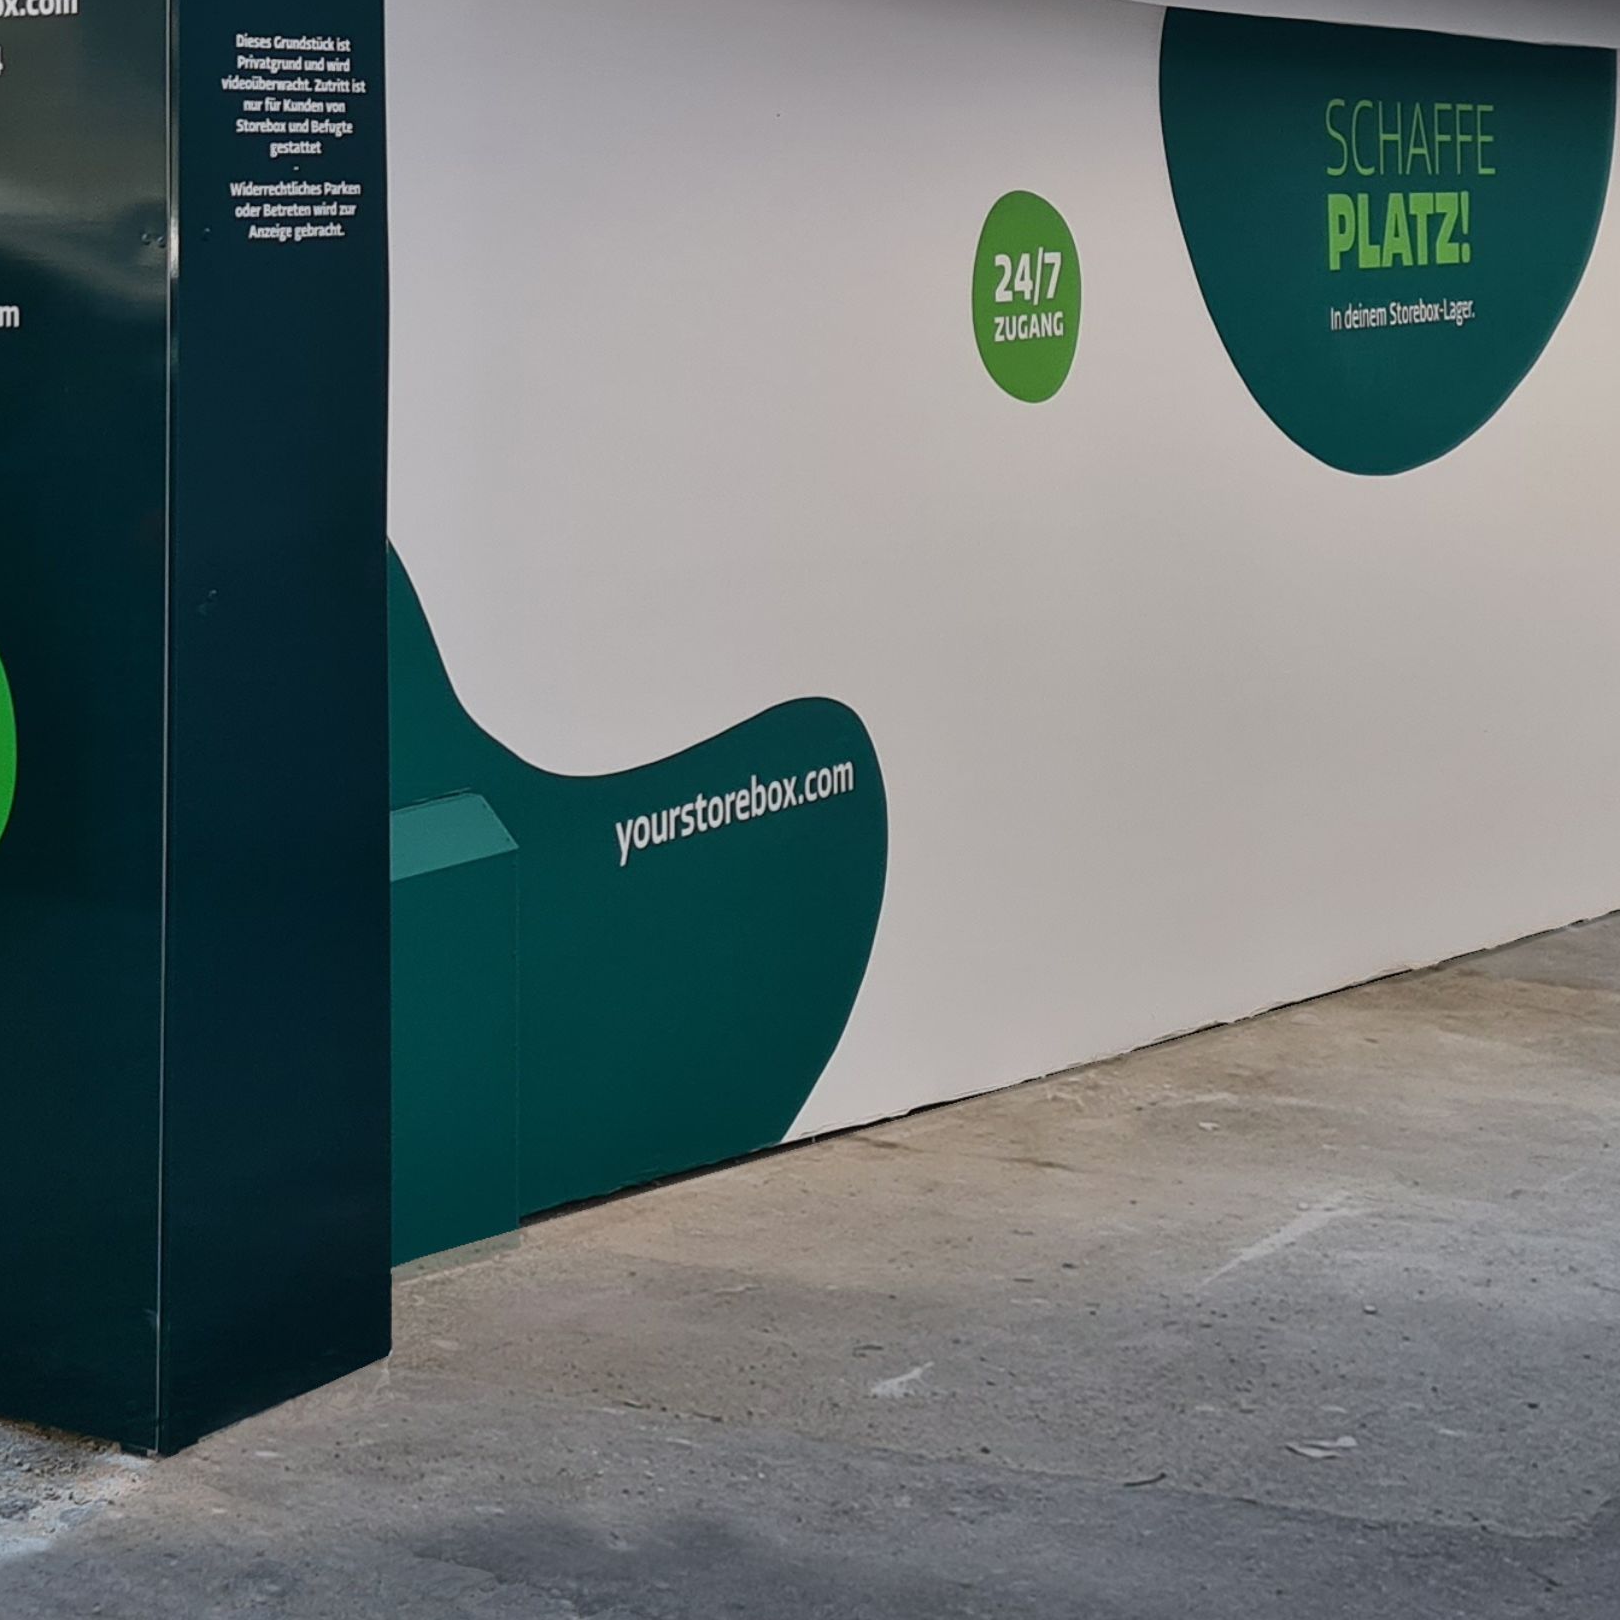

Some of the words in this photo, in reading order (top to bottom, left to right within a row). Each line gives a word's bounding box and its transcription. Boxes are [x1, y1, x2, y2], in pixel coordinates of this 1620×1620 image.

[235, 33, 272, 49] Dieses
[273, 35, 335, 51] Grundstück
[336, 37, 351, 52] ist
[237, 54, 302, 74] Privatgrund
[304, 56, 324, 71] und
[326, 58, 350, 72] wird
[221, 75, 312, 91] videoüberwacht.
[314, 78, 350, 93] Zutritt
[352, 78, 366, 93] ist
[243, 99, 263, 111] nur
[265, 96, 281, 111] für
[283, 98, 324, 112] Kunden
[325, 102, 346, 113] von
[235, 118, 286, 133] Storebox
[288, 118, 309, 133] und
[311, 119, 353, 137] Befugte
[1325, 98, 1496, 176] SCHAFFE
[270, 140, 322, 158] gestattet
[230, 181, 322, 196] Widerrechtliches
[323, 180, 361, 195] Parken
[235, 203, 261, 218] oder
[263, 204, 311, 217] Betreten
[313, 201, 337, 216] wird
[339, 204, 356, 215] zur
[248, 223, 292, 242] Anzeige
[294, 222, 345, 242] gebracht.
[1328, 191, 1471, 271] PLATZ!
[994, 247, 1062, 306] 24/7
[1330, 306, 1342, 331] In
[1344, 303, 1387, 329] deinem
[1389, 298, 1476, 327] Storebox-Lager.
[994, 311, 1064, 342] ZUGANG
[615, 761, 854, 867] yourstorebox.com
